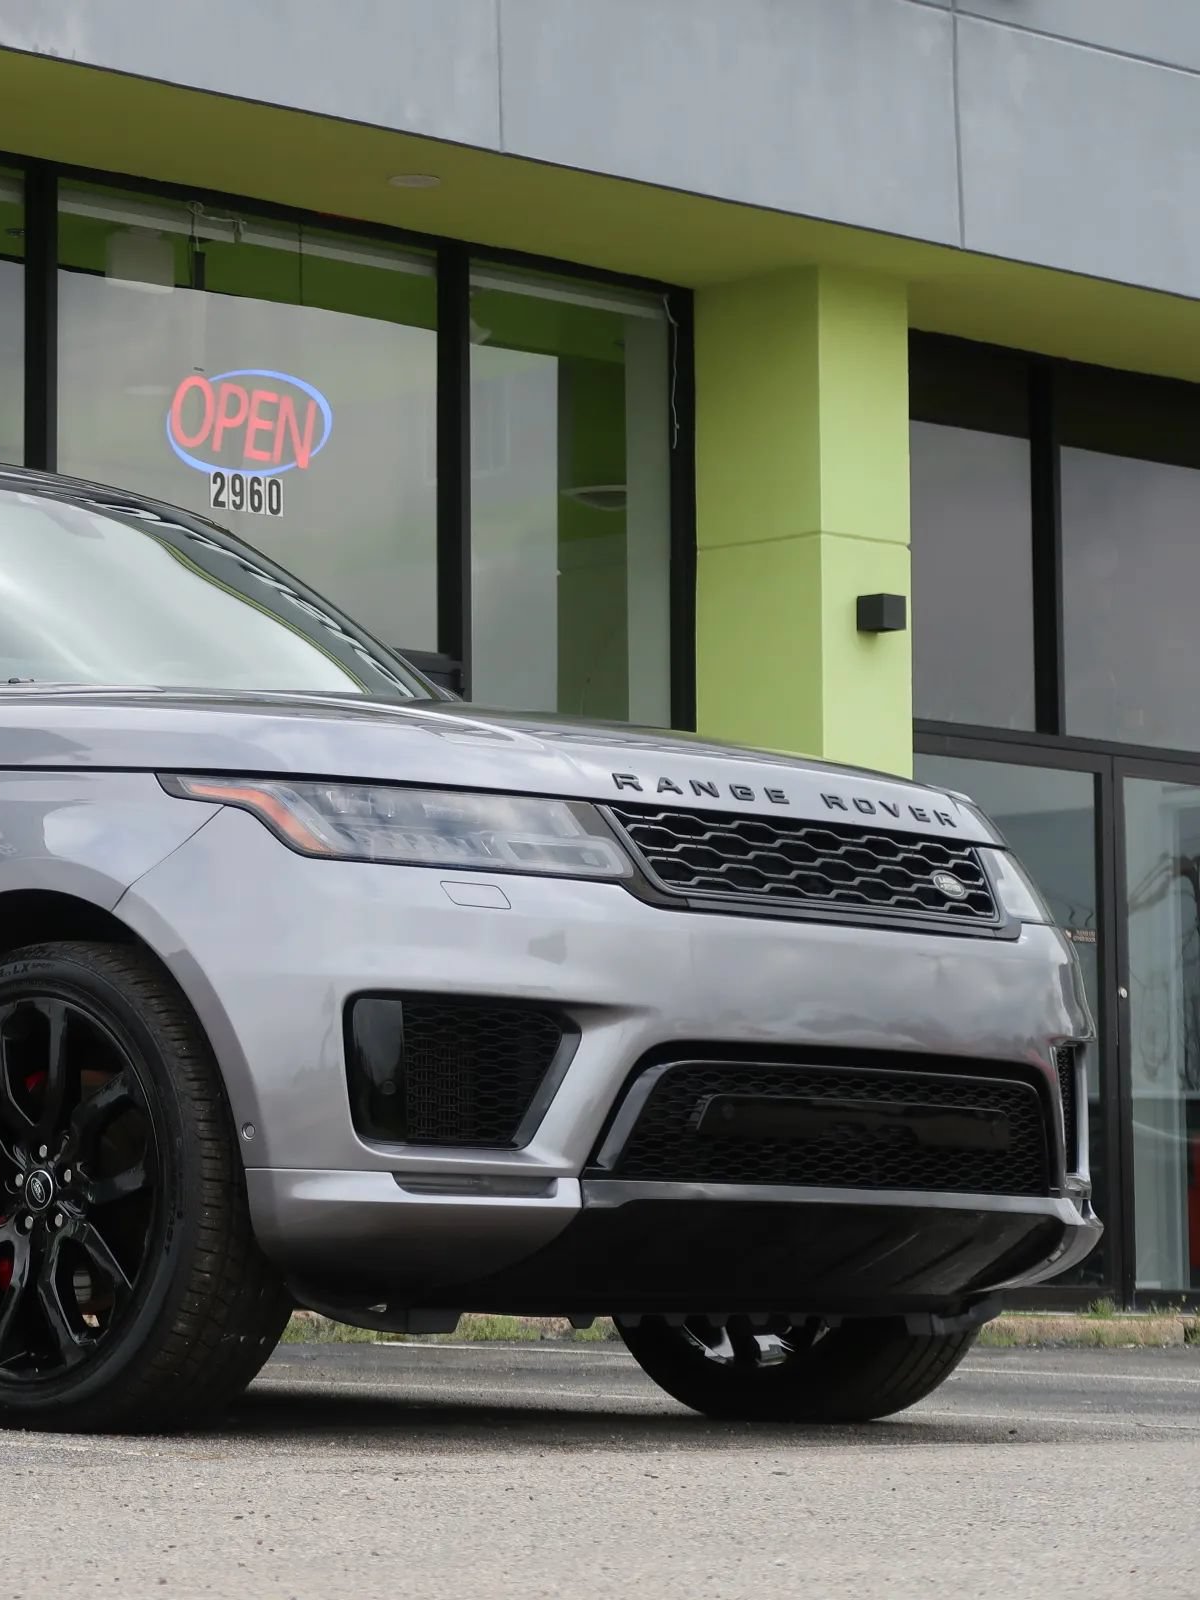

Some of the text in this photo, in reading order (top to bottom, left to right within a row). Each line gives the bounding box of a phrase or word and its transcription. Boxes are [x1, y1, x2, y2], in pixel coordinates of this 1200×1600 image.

[171, 375, 317, 469] OPEN
[212, 471, 282, 515] 2960
[611, 772, 957, 828] RANGE ROVER
